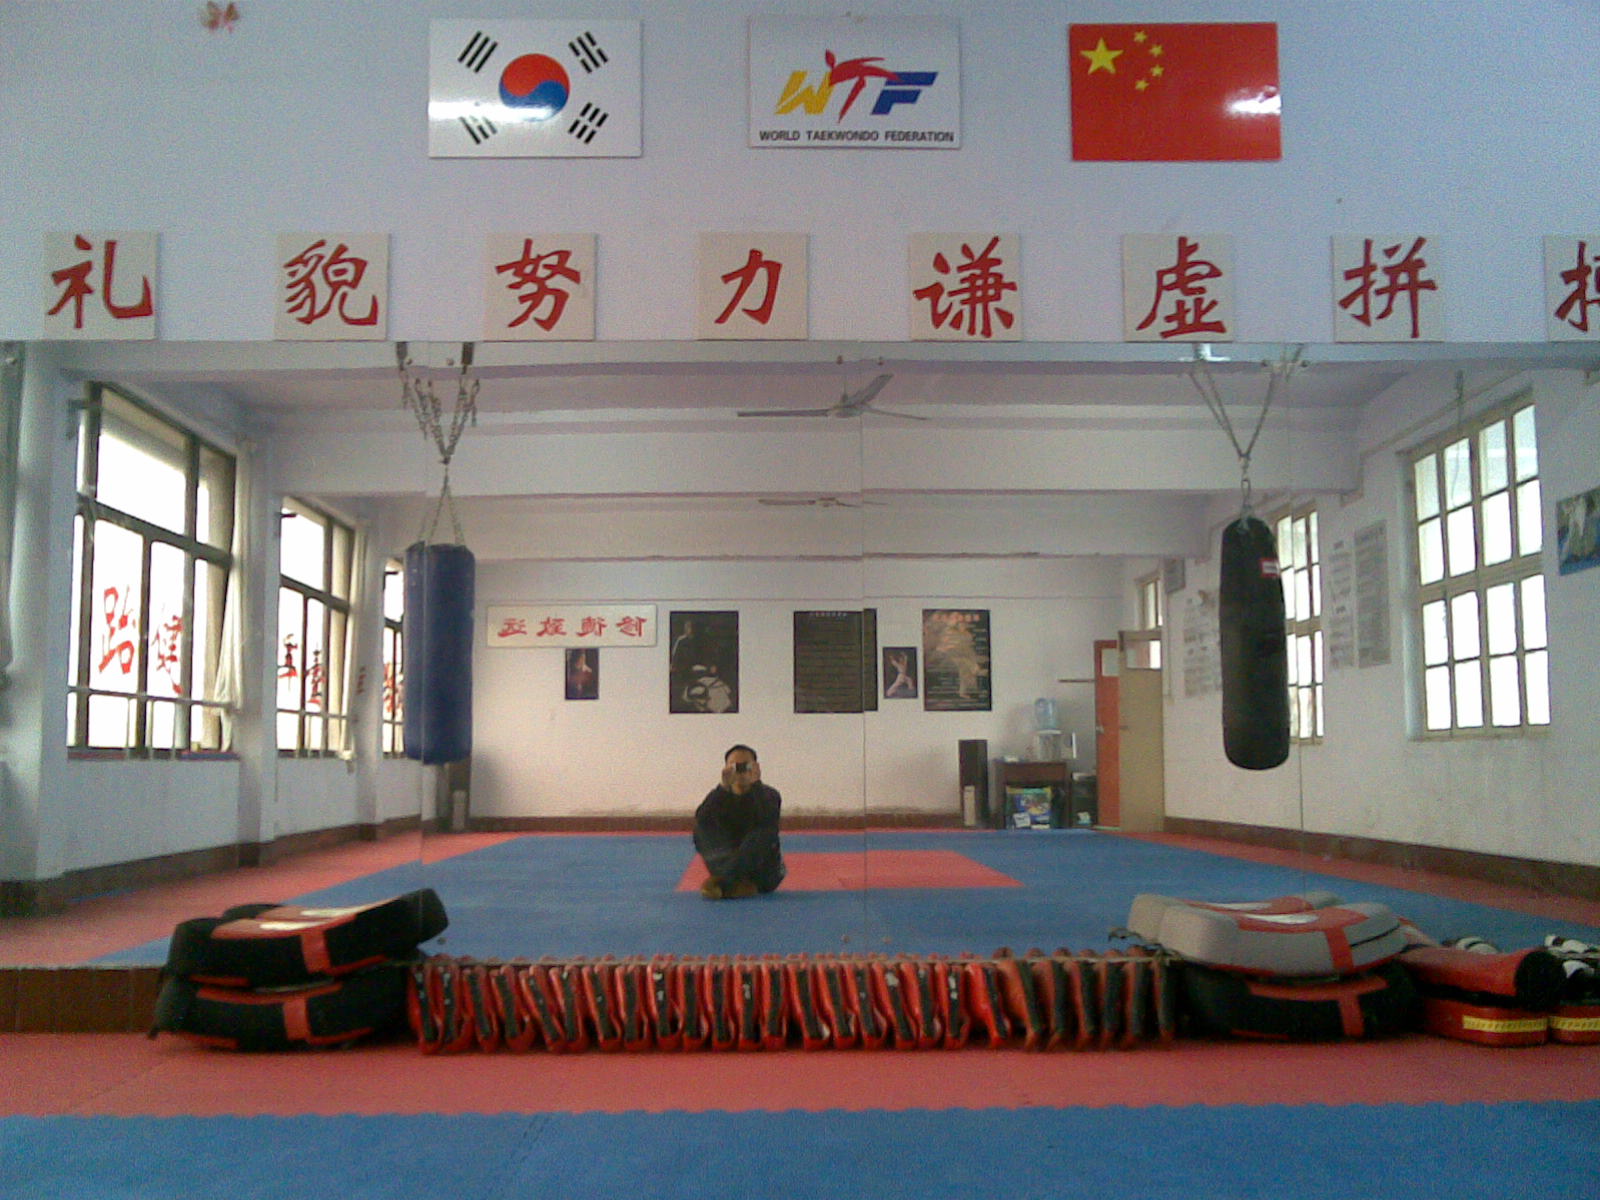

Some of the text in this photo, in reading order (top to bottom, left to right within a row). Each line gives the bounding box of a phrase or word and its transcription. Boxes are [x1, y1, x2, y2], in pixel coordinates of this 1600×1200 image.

[759, 130, 954, 142] WORLD TAEKWONDO FEDERATION
